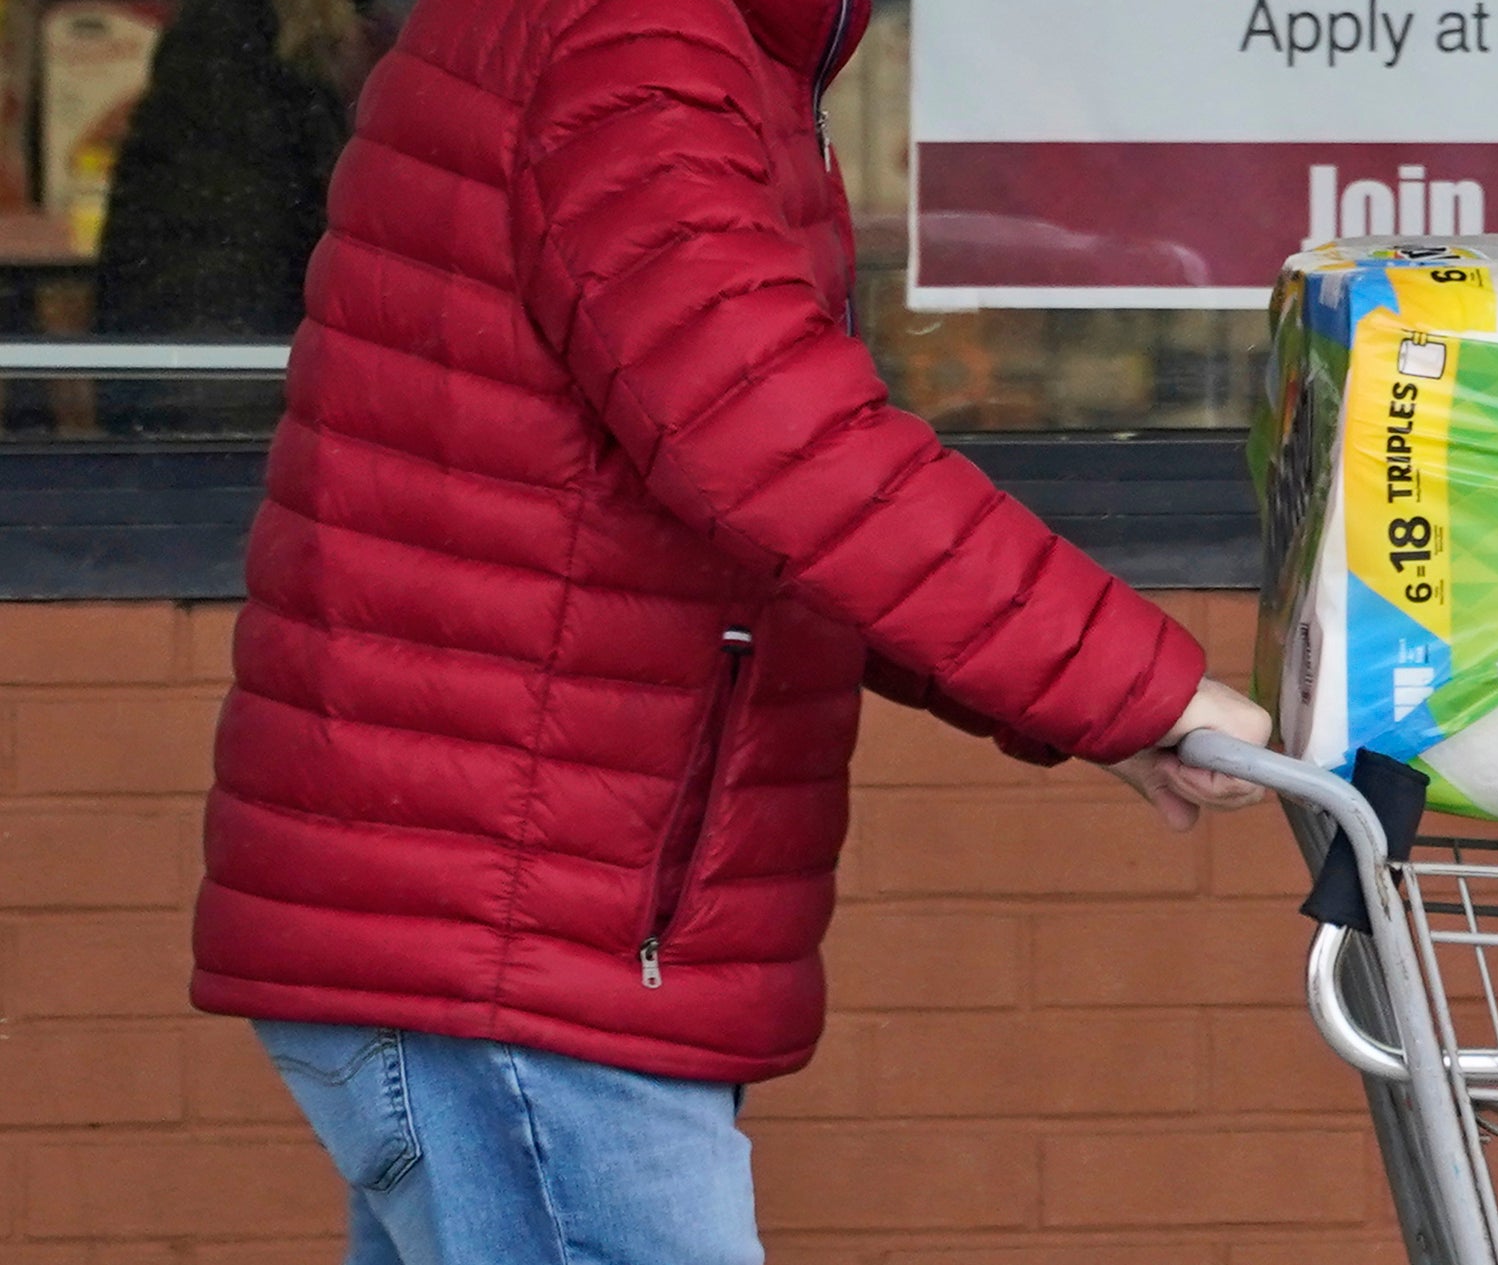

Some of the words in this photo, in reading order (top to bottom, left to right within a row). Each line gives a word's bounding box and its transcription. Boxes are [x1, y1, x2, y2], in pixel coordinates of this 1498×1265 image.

[1242, 0, 1414, 69] Apply
[1437, 3, 1490, 54] at
[1302, 164, 1486, 250] Join
[1386, 381, 1419, 505] TRIPLES
